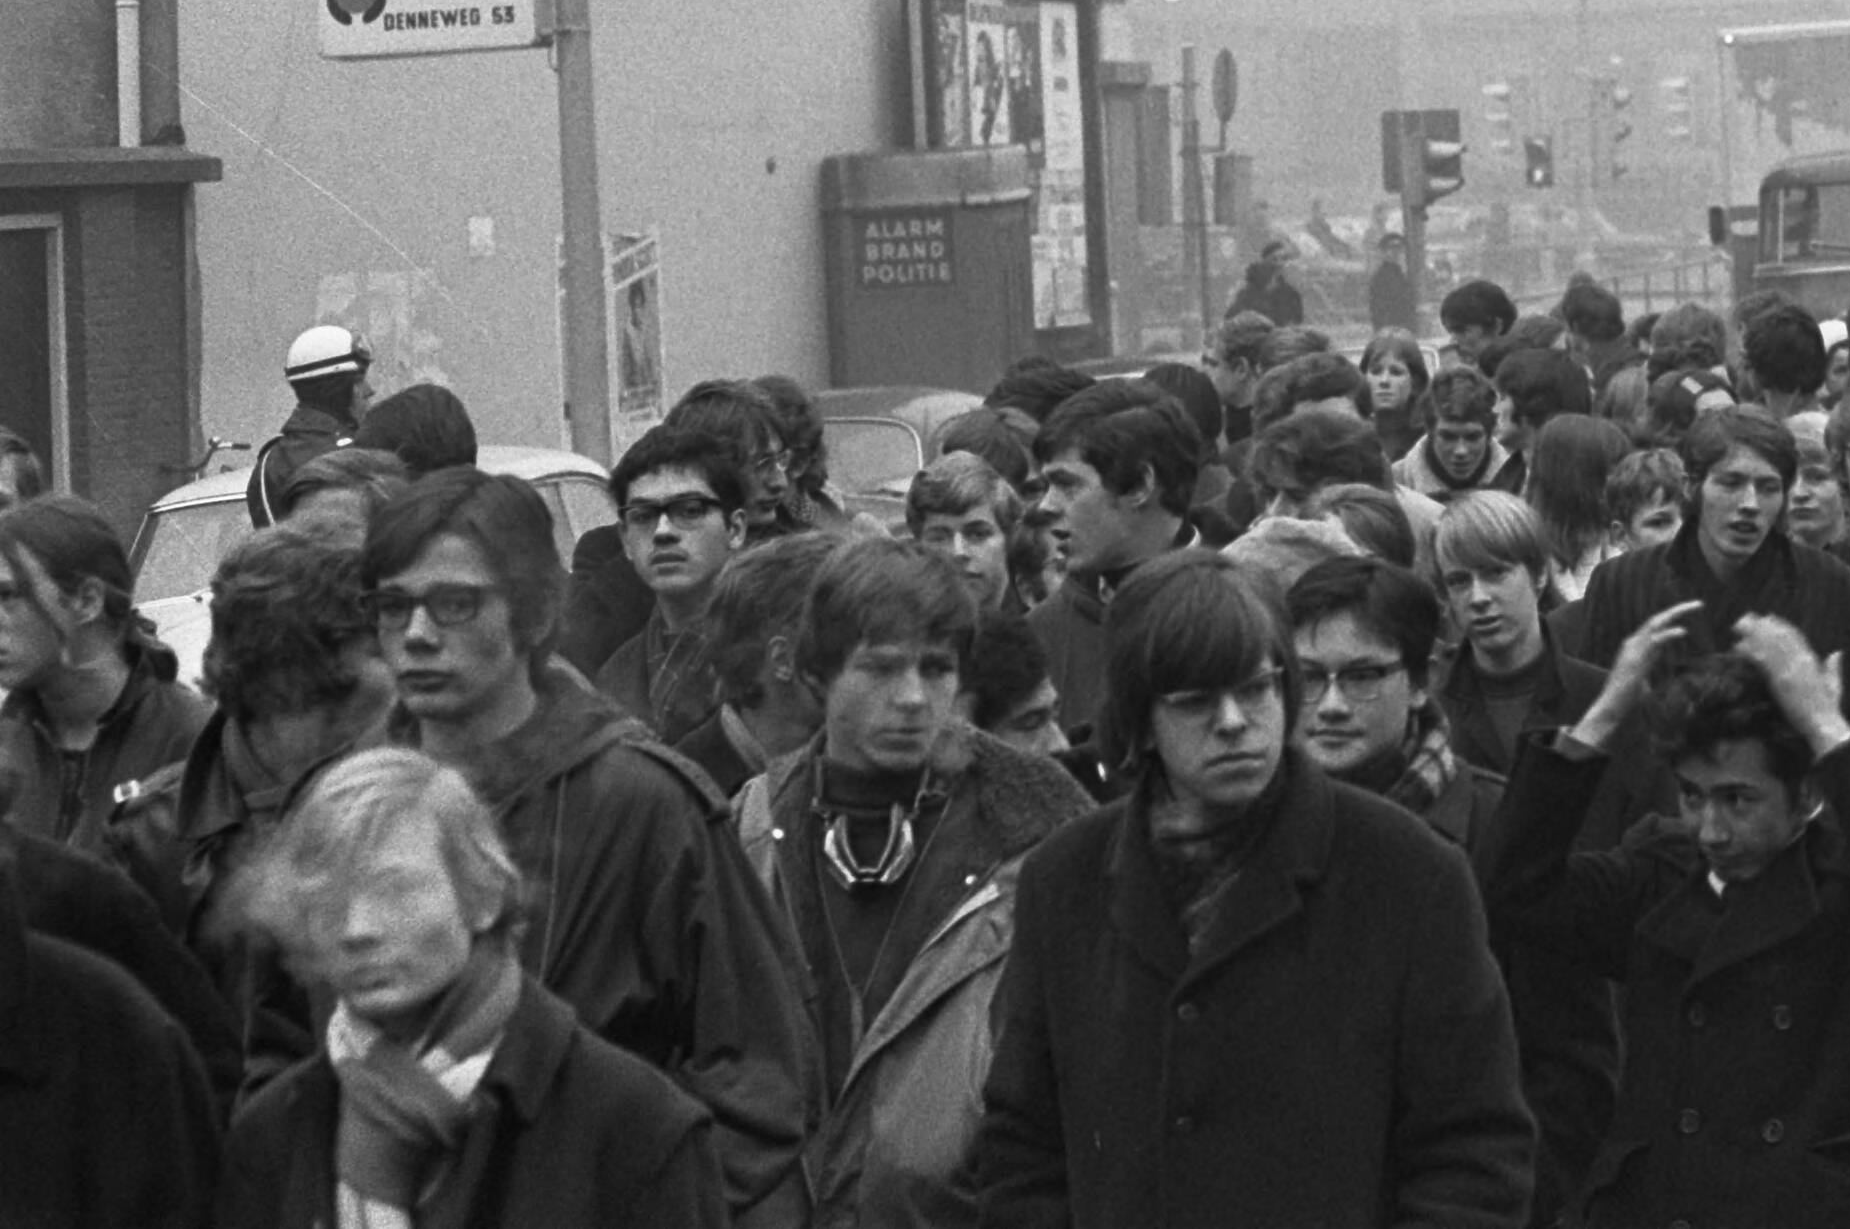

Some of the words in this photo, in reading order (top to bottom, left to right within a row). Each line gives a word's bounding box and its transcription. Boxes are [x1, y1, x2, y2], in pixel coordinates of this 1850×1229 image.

[383, 7, 481, 32] DENNEWEG
[491, 5, 515, 25] 53
[865, 219, 944, 239] ALARM
[865, 241, 944, 261] BRAND
[862, 262, 951, 285] POLITIE
